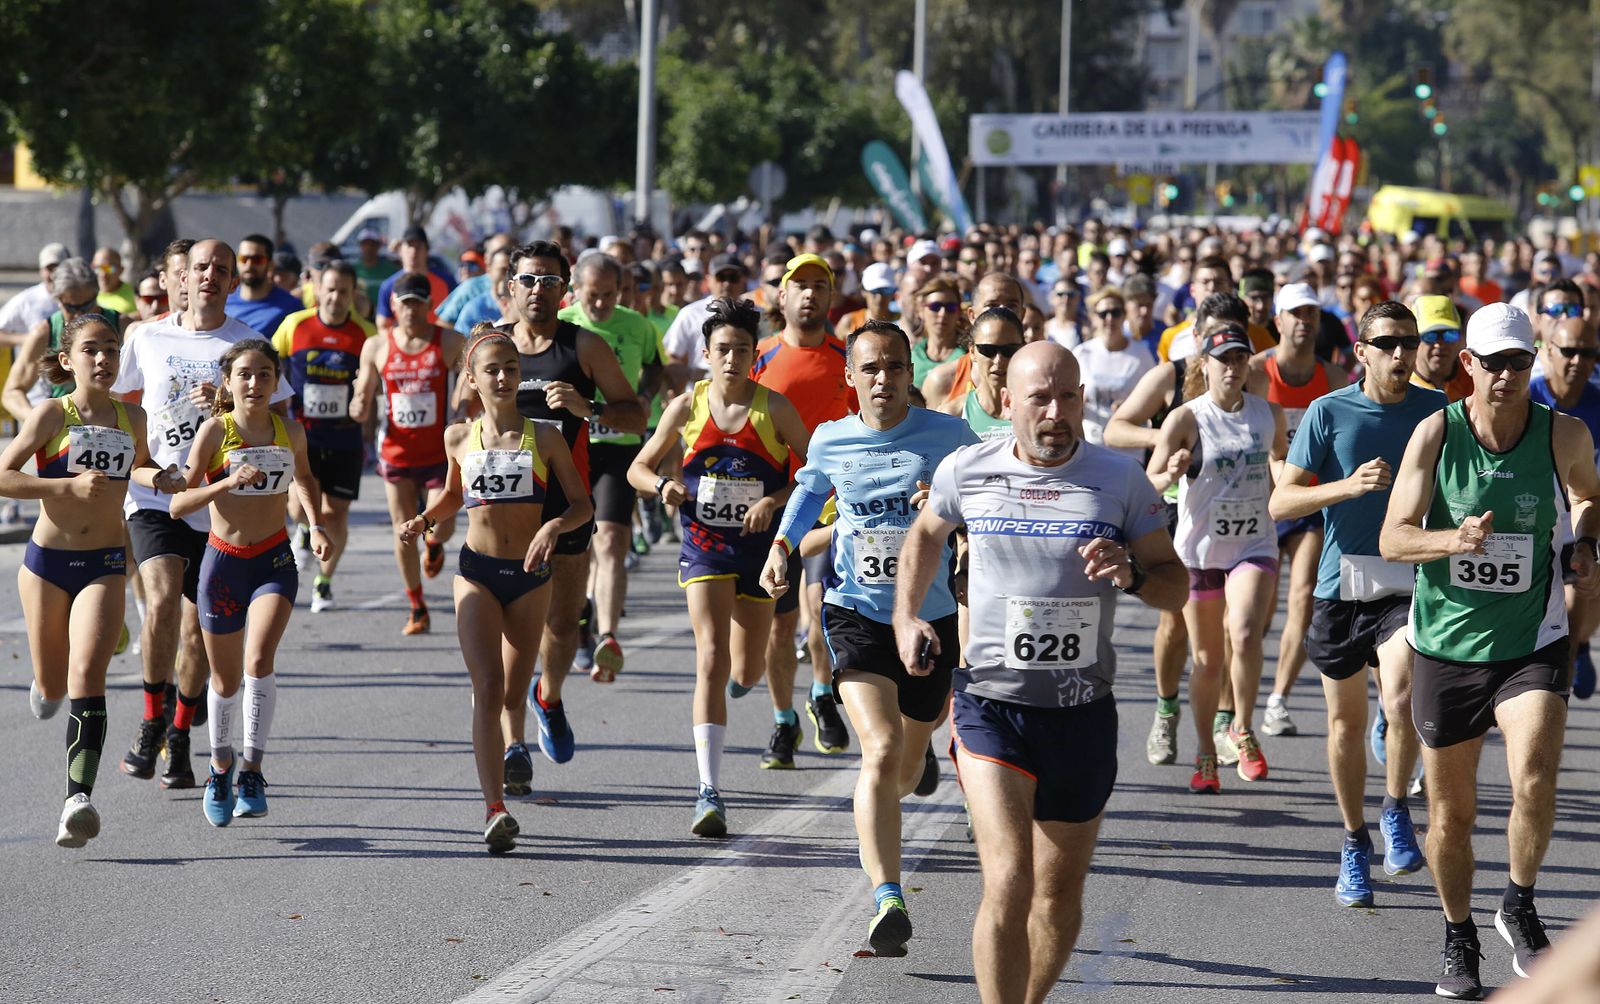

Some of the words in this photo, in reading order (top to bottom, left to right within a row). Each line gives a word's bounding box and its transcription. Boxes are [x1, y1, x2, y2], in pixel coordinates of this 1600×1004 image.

[1033, 120, 1120, 138] CARRERA
[1123, 120, 1146, 137] DE
[1152, 120, 1176, 136] LA
[1181, 119, 1251, 137] PRENSA
[309, 401, 338, 414] 708
[397, 410, 427, 423] 207
[75, 449, 125, 472] 481
[470, 474, 523, 494] 437
[1021, 489, 1060, 500] COLLADO
[702, 502, 750, 522] 548
[1215, 518, 1259, 536] 372
[1457, 560, 1520, 586] 395
[1014, 633, 1081, 662] 628
